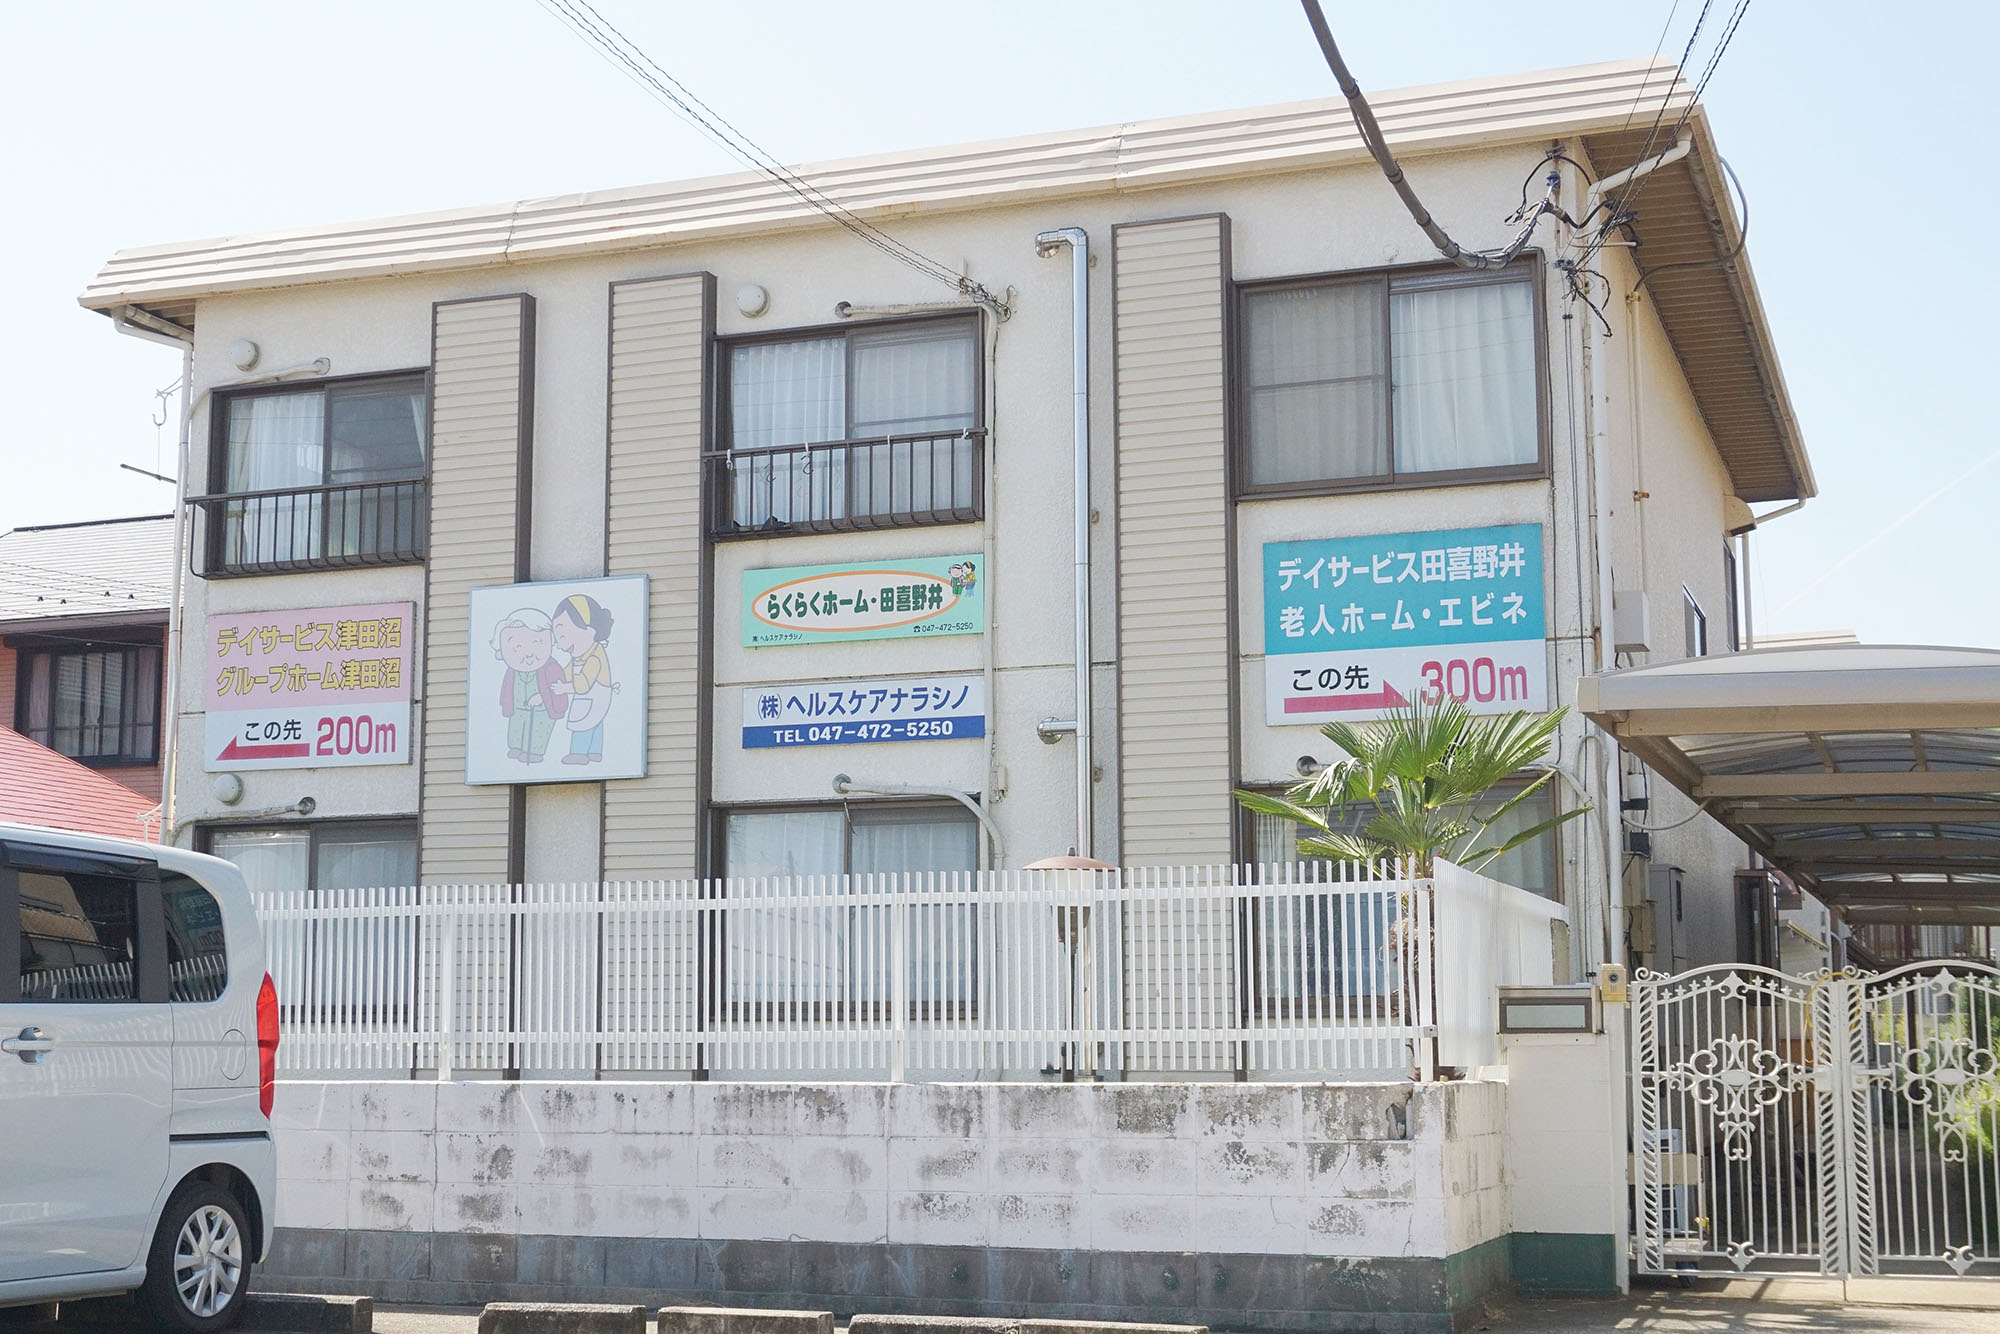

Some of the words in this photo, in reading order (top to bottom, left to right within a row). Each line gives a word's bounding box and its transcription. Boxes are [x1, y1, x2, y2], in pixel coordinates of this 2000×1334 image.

[1278, 541, 1526, 592] デイサービス田喜野井
[767, 582, 943, 620] らくらくホーム・田喜野井
[1279, 591, 1528, 638] 老人ホーム・エビネ
[217, 617, 403, 657] デイサービス津田沼
[921, 622, 974, 633] 047-472-5250
[216, 657, 402, 697] グループホーム津田沼
[1292, 664, 1370, 691] この先
[1421, 656, 1529, 706] 300m
[244, 719, 302, 741] この先
[316, 714, 397, 756] 200m
[773, 729, 805, 743] TEL
[808, 719, 954, 742] 047-472-5250
